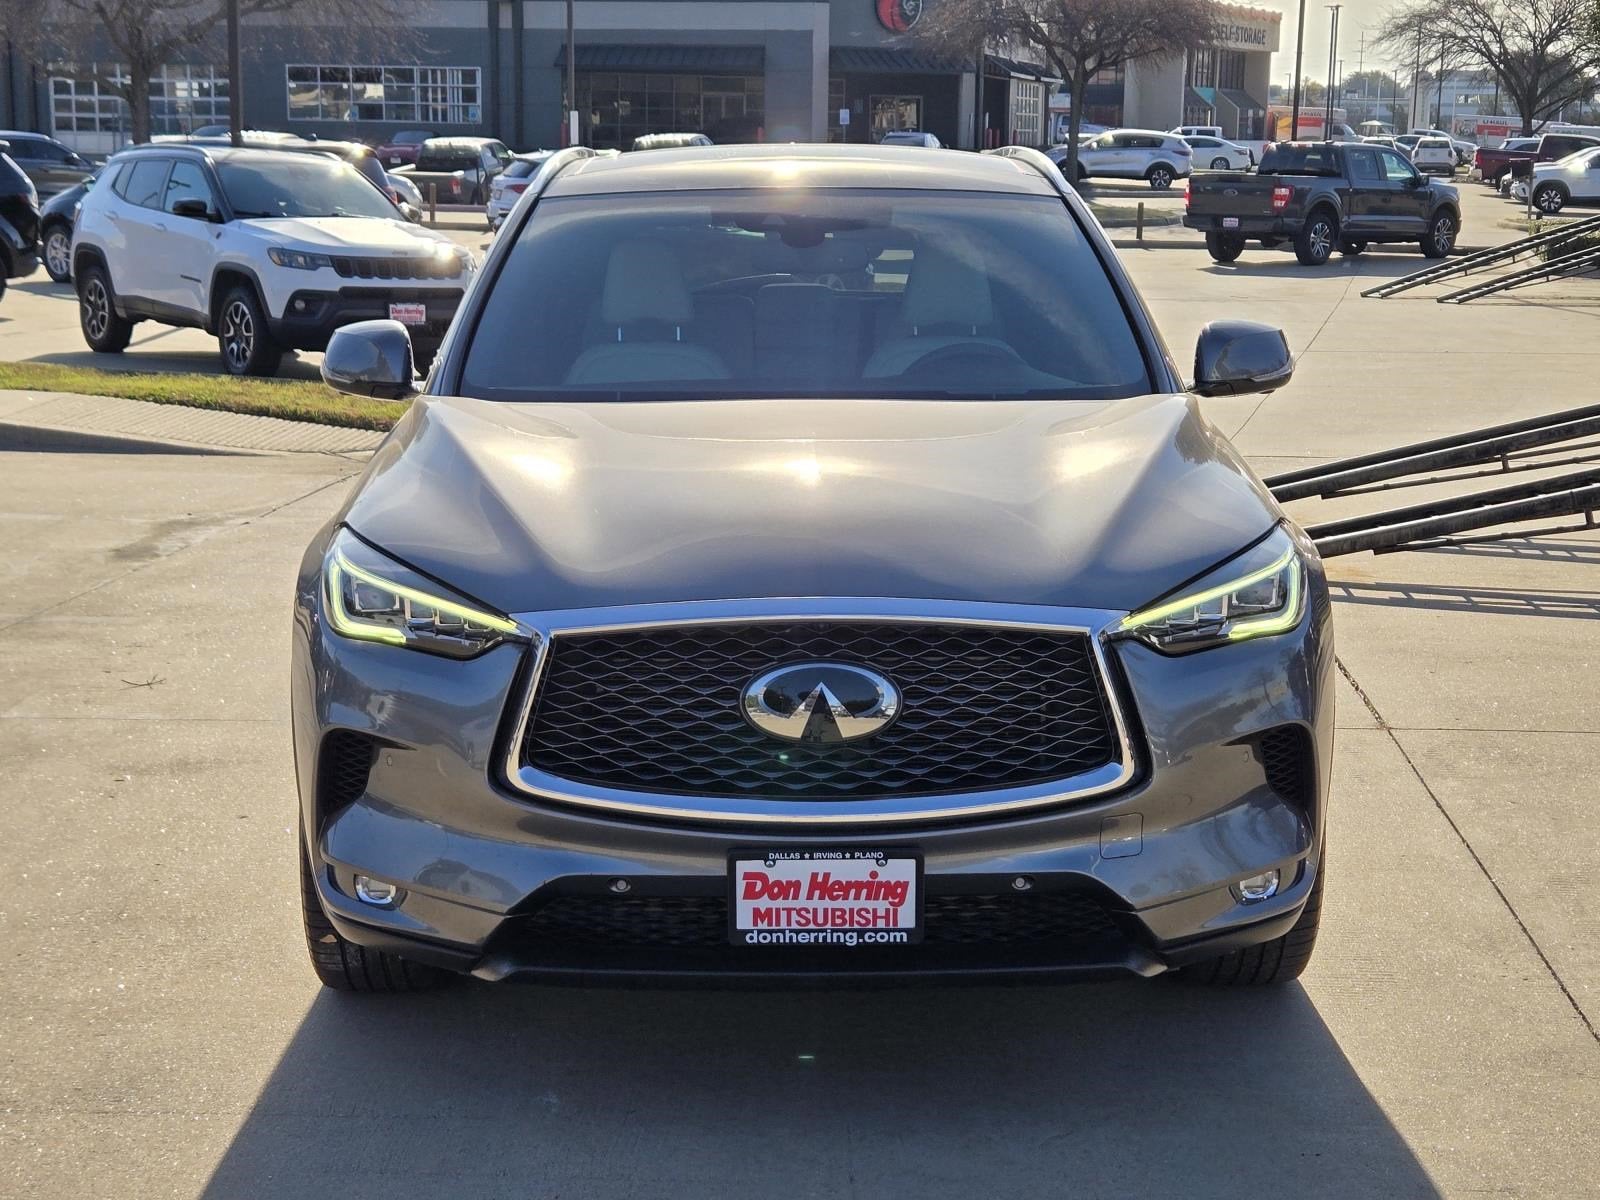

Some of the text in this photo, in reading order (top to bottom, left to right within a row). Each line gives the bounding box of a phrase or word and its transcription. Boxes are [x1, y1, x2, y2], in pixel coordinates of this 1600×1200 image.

[768, 852, 801, 860] DALLAS
[854, 851, 884, 859] PLANO
[742, 870, 910, 907] Don Herring
[752, 906, 899, 928] MITSUBISHI
[745, 929, 908, 946] donherring.com
